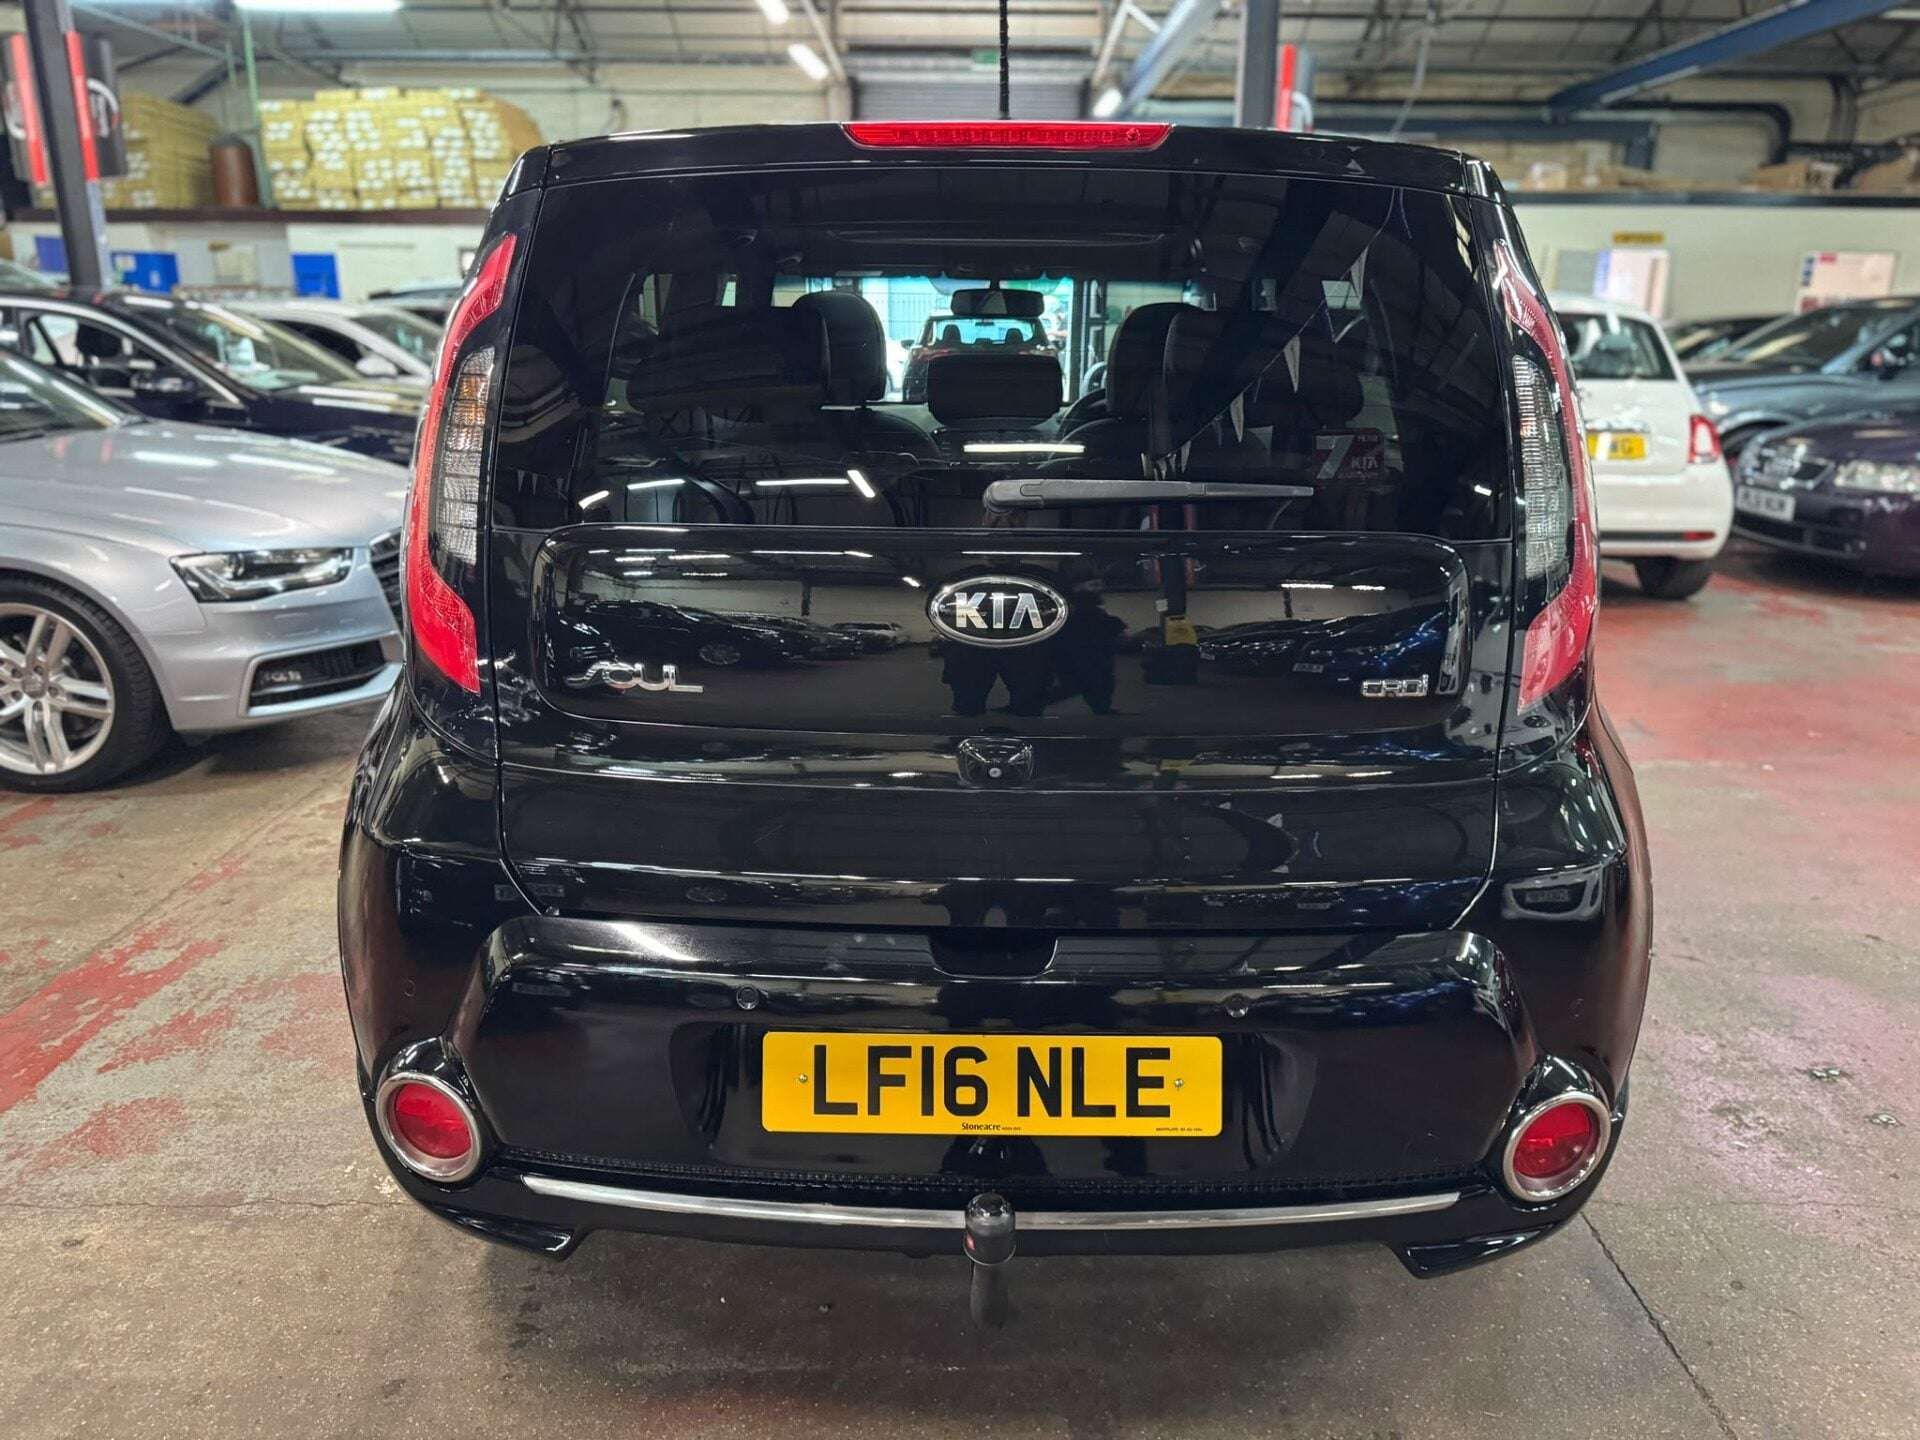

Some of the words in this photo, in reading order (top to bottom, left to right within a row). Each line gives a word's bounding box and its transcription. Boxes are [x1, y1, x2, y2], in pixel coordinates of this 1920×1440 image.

[954, 592, 1044, 629] KIA
[565, 660, 704, 693] SOUL
[813, 1044, 989, 1116] LF16
[1017, 1046, 1171, 1117] NLE
[961, 1121, 1001, 1131] Stoneacre
